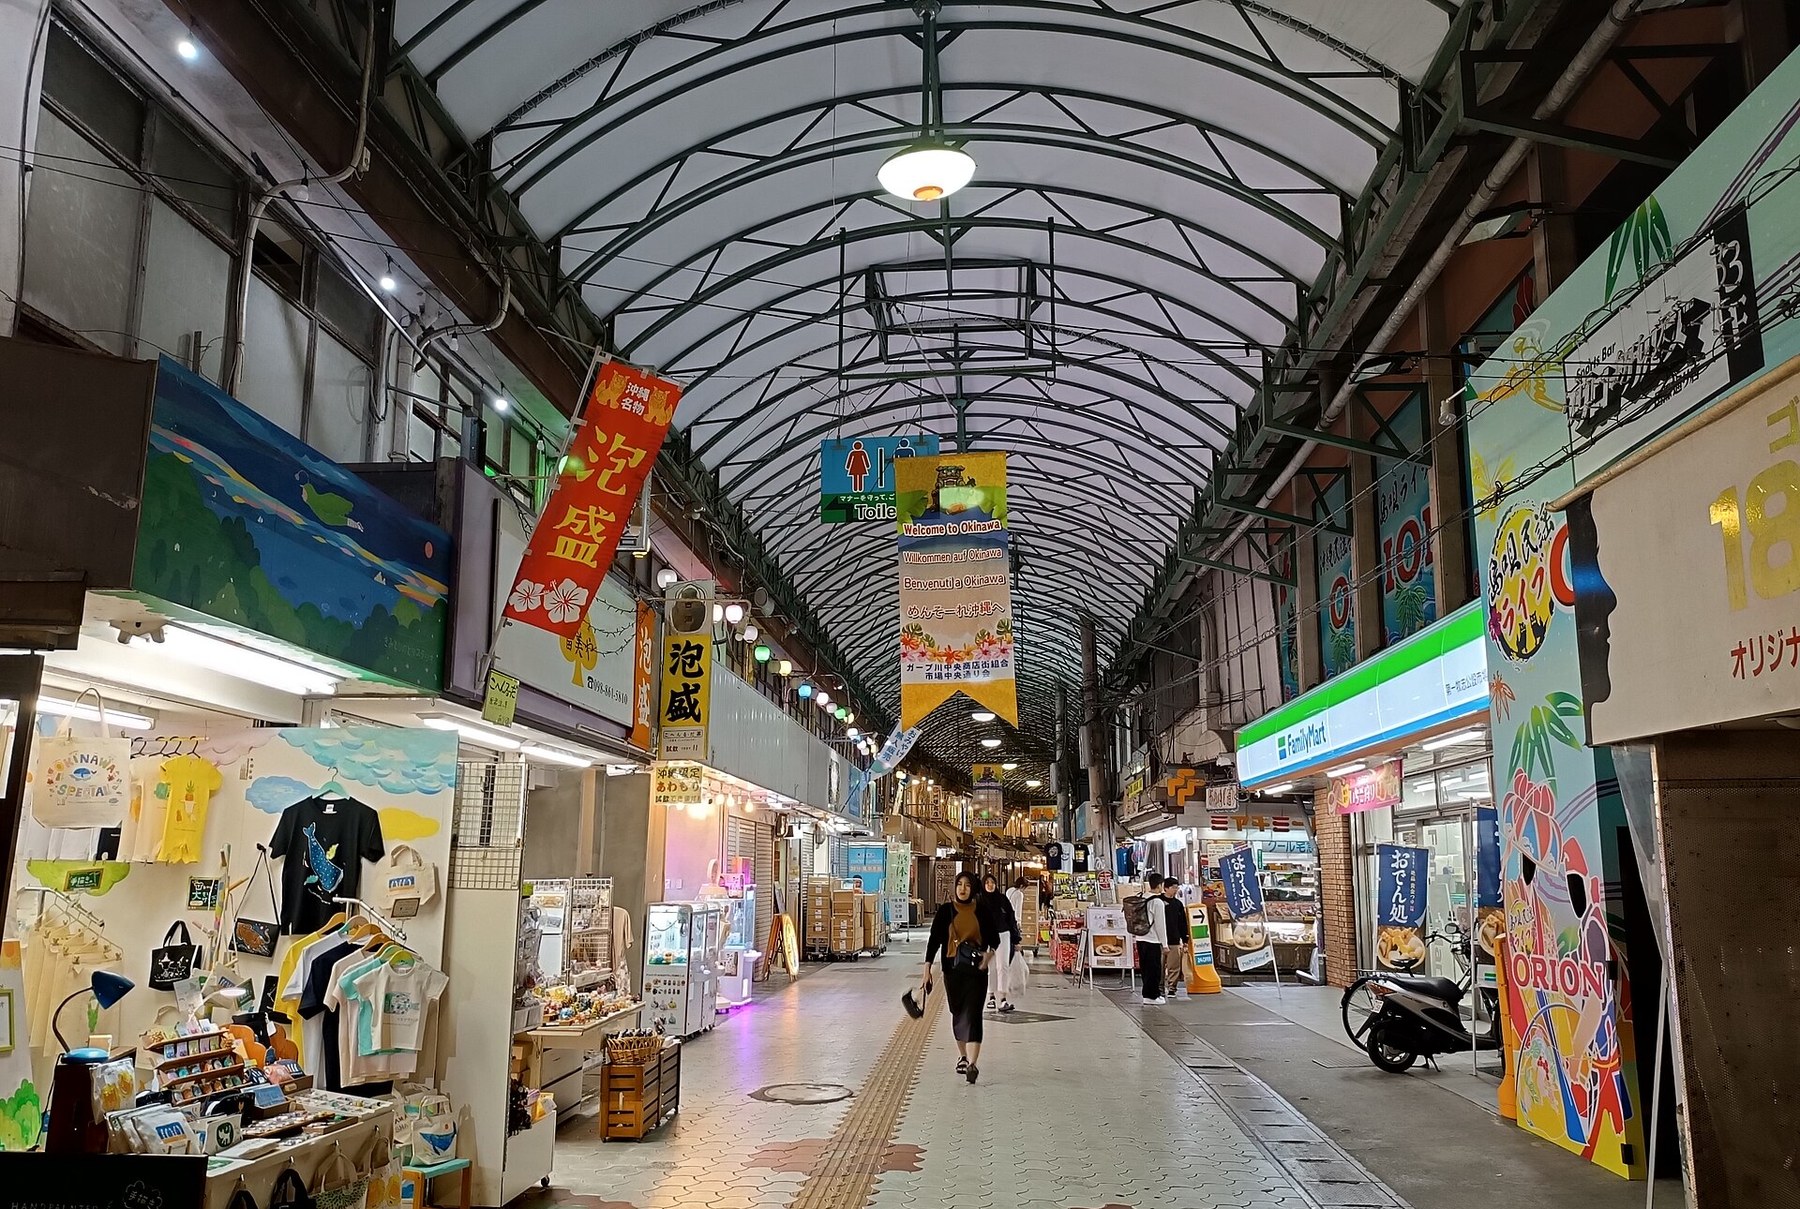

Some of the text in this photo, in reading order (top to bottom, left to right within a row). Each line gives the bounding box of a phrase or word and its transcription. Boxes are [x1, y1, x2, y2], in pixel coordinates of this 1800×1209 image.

[1602, 342, 1617, 361] Bar
[625, 382, 650, 402] 沖縄
[621, 397, 645, 416] 名物
[547, 425, 647, 569] 泡盛
[904, 520, 1001, 537] Welcome to Okinawa
[903, 548, 1002, 565] Willkommen auf Okinawa
[904, 574, 1006, 591] Benvenuti a Okinawa
[907, 601, 1006, 619] めんそーれ沖縄へ
[665, 639, 705, 724] 泡盛
[1287, 720, 1327, 756] FamilyMart
[1389, 849, 1411, 924] おでん処
[1512, 953, 1605, 1002] ORION
